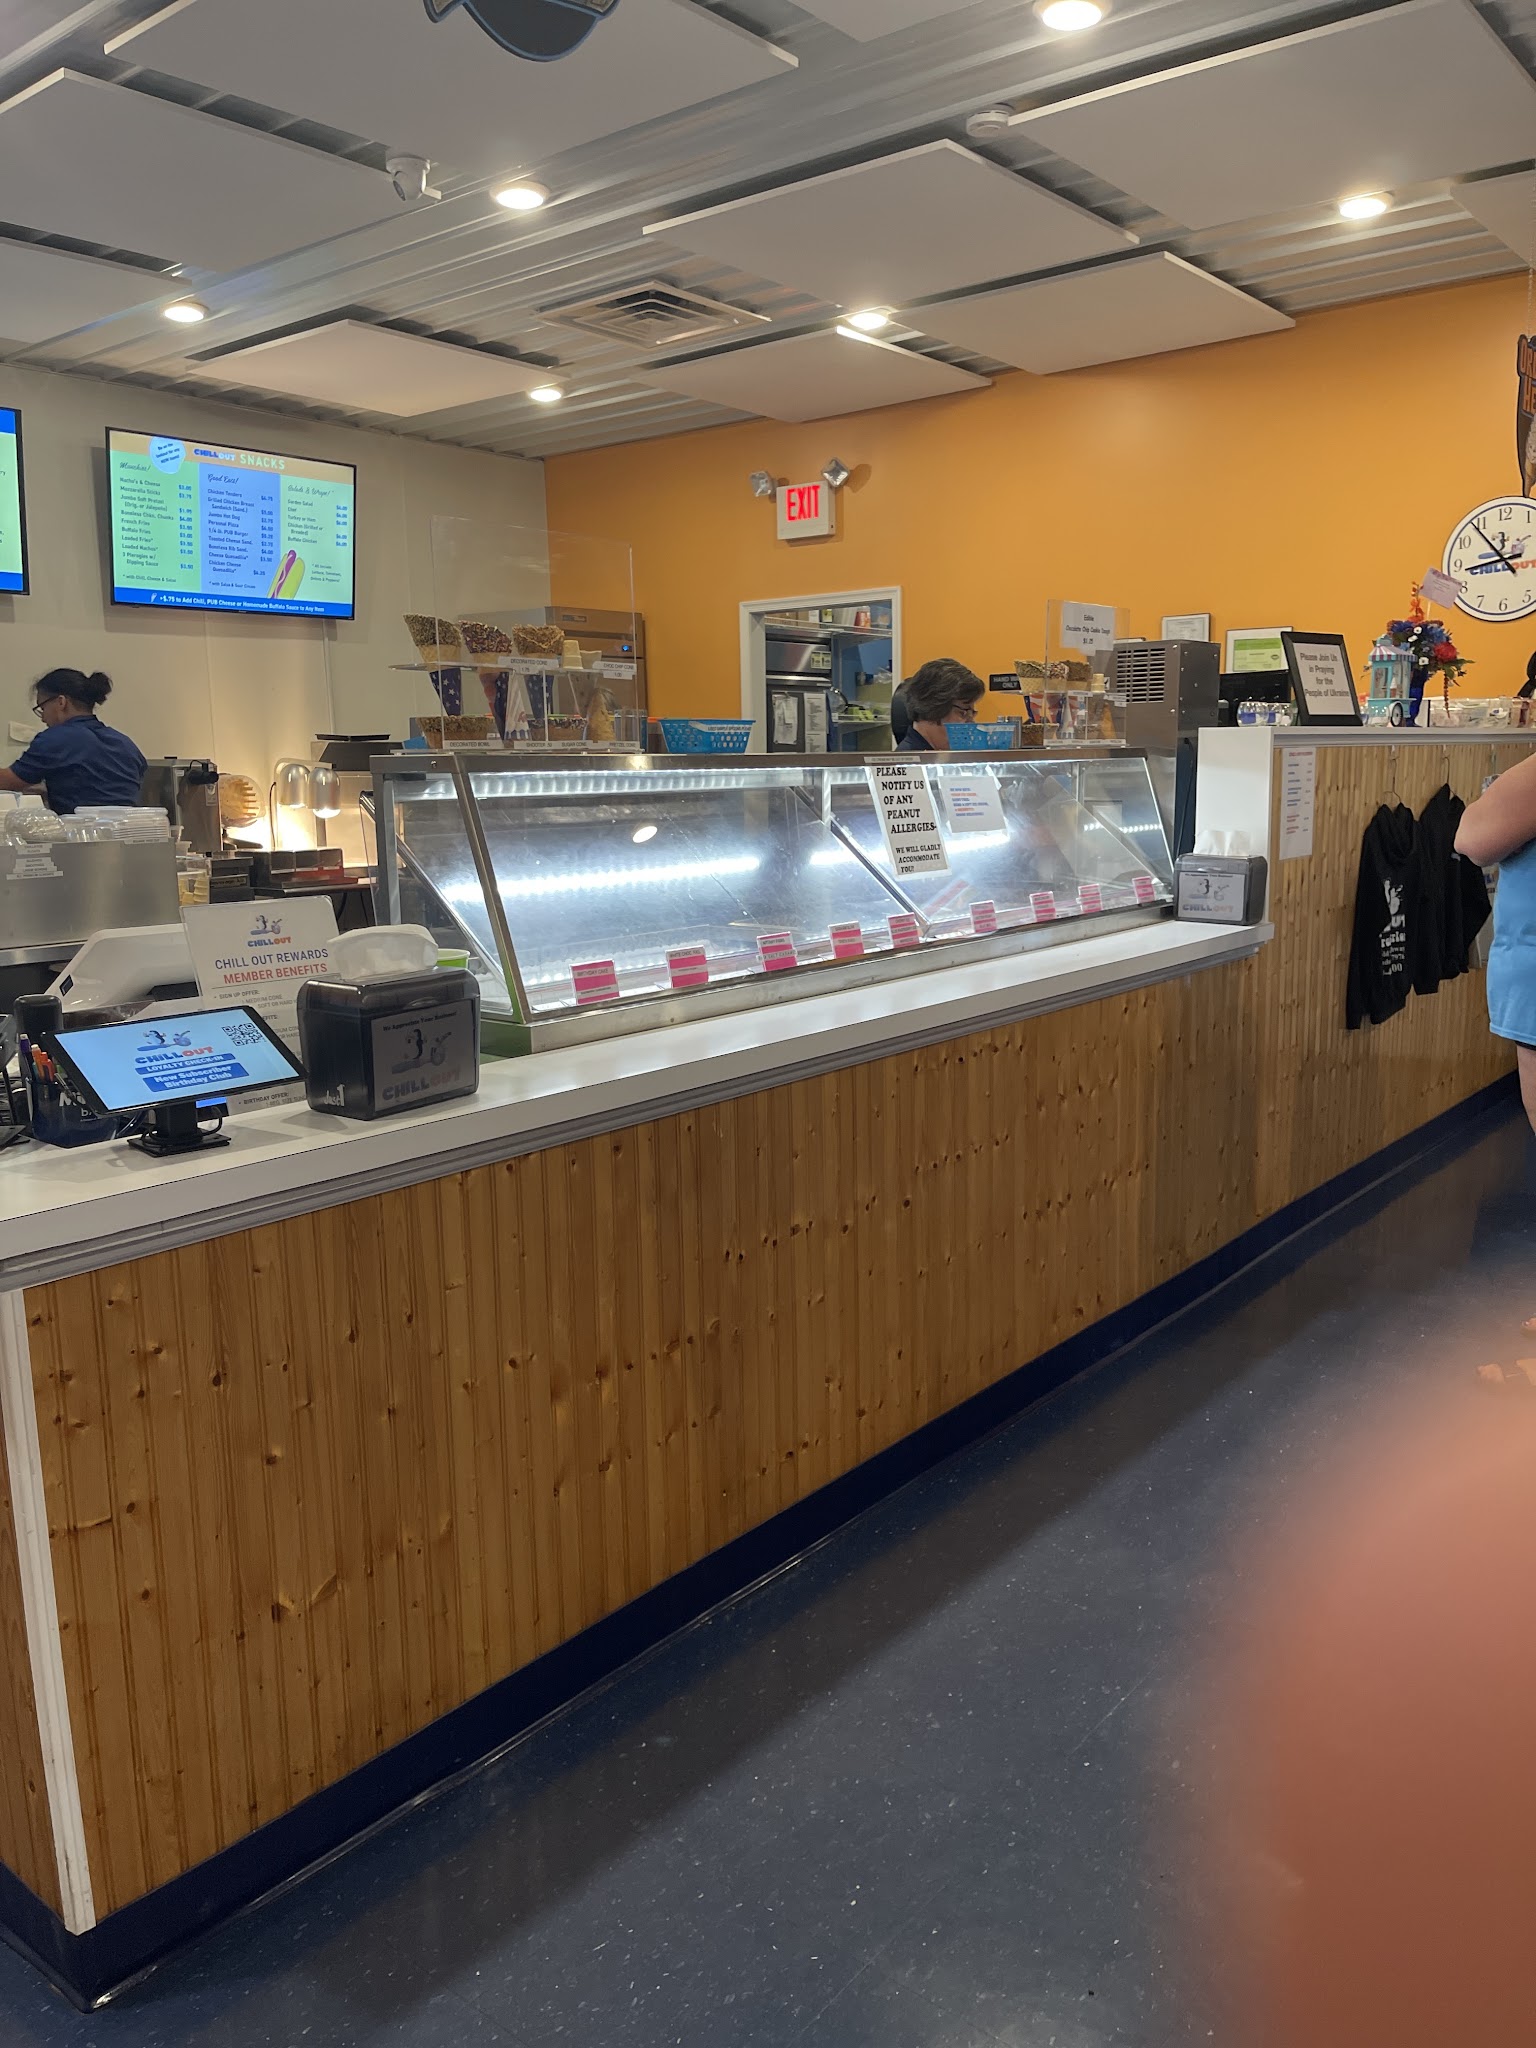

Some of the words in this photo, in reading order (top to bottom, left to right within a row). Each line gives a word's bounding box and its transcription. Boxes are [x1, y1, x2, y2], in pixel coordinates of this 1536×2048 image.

[240, 454, 285, 470] SNACKS
[120, 486, 146, 494] Mozzarella
[786, 484, 820, 522] EXIT
[1499, 507, 1512, 521] 12
[1527, 511, 1531, 523] 1
[1476, 517, 1487, 530] 11
[234, 530, 248, 538] Burger
[1459, 535, 1471, 549] 10
[1454, 559, 1463, 573] 9
[1460, 581, 1468, 594] 8
[1477, 595, 1485, 608] 7
[1522, 589, 1532, 603] 5
[1499, 598, 1508, 611] 6
[1300, 653, 1318, 661] Please
[1331, 654, 1337, 662] Us
[1315, 665, 1335, 675] Praying
[1304, 689, 1323, 698] People
[876, 767, 907, 778] PLEASE
[881, 781, 912, 791] NOTIFY
[914, 781, 924, 790] US
[884, 796, 894, 805] OF
[896, 795, 913, 805] ANY
[888, 809, 920, 820] PEANUT
[891, 822, 937, 834] ALLERGIES-
[920, 844, 941, 853] GLADLY
[898, 854, 940, 864] ACCOMMODATE
[247, 936, 291, 947] CHILLOUT
[215, 958, 249, 970] CHILL
[251, 954, 273, 967] OUT
[276, 948, 328, 964] REWARDS
[223, 969, 273, 984] MEMBER
[276, 963, 328, 978] BENEFITS
[245, 996, 267, 1004] MEDIUM
[391, 1019, 419, 1030] Appreciate
[135, 1046, 214, 1064] CHILLOUT
[147, 1061, 183, 1072] LOYALTY
[184, 1055, 224, 1067] CHECK-IN
[154, 1074, 177, 1083] New
[178, 1065, 232, 1079] Subscriber
[164, 1076, 209, 1088] Birthday
[209, 1072, 232, 1081] Club
[382, 1063, 461, 1101] CHILLOUT
[244, 1096, 270, 1105] BIRTHDAY
[271, 1092, 289, 1100] OFFER:
